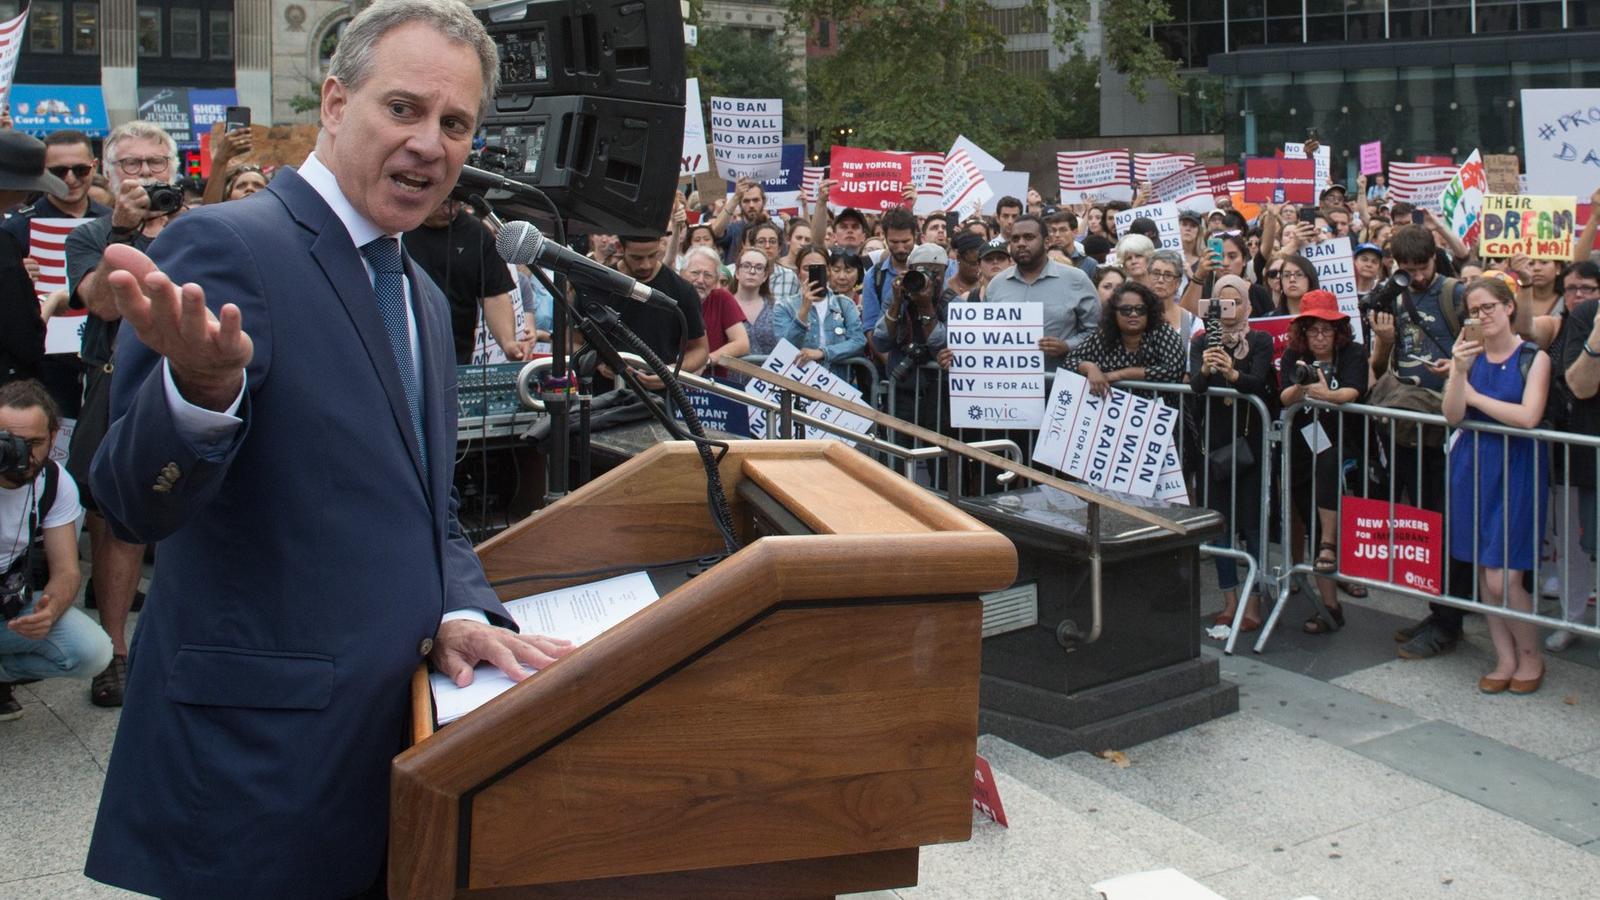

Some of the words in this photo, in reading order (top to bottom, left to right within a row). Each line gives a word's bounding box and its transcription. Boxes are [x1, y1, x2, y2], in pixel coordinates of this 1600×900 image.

[153, 104, 178, 112] HAIR
[193, 104, 223, 114] SHOE
[712, 100, 732, 111] NO
[737, 103, 767, 112] BAN
[713, 117, 732, 127] NO
[737, 120, 776, 128] WALL
[714, 133, 733, 143] NO
[737, 136, 780, 145] RAIDS
[715, 149, 731, 159] NY
[843, 162, 863, 170] NEW
[866, 162, 902, 170] YORKERS
[840, 180, 903, 193] JUSTICE!
[1484, 196, 1532, 209] THEIR
[1116, 214, 1132, 224] NO
[1484, 210, 1572, 240] DREAM
[1306, 244, 1335, 258] BAN
[1322, 282, 1354, 294] AIDS
[950, 308, 976, 320] NO
[984, 308, 1022, 320] BAN
[950, 332, 976, 344] NO
[983, 332, 1034, 344] WALL
[952, 356, 976, 368] NO
[984, 356, 1040, 368] RAIDS
[952, 379, 975, 391] NY
[1021, 382, 1040, 390] ALL
[1107, 391, 1126, 420] NO
[984, 404, 1017, 423] nyic
[1130, 400, 1148, 428] NO
[1050, 405, 1068, 441] nyic
[1082, 416, 1092, 426] IS
[1154, 407, 1172, 436] NO
[1076, 428, 1088, 450] FOR
[1070, 452, 1081, 470] ALL
[1090, 424, 1115, 486] RAIDS
[1112, 434, 1138, 484] WALL
[1139, 441, 1162, 483] BAN
[1165, 482, 1181, 492] ALL
[1357, 517, 1383, 529] NEW
[1356, 530, 1371, 540] FOR
[1354, 543, 1430, 564] JUSTICE!
